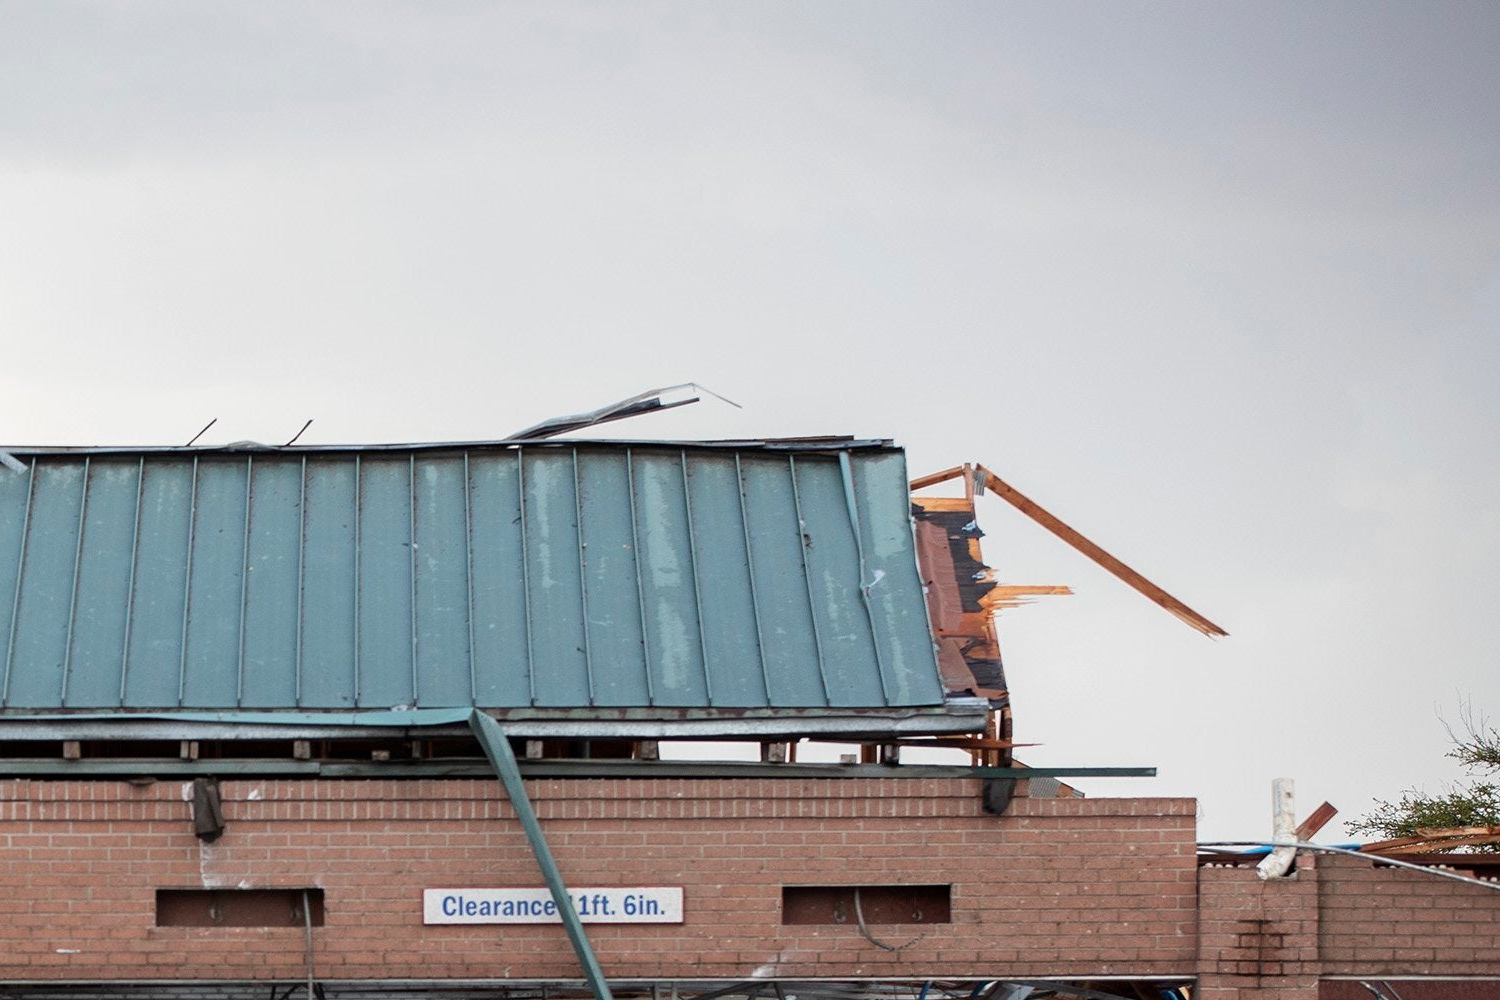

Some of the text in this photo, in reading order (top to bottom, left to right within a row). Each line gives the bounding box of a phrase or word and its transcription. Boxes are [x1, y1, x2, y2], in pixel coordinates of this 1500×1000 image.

[442, 895, 666, 917] Clearance 1ft. 6in.
